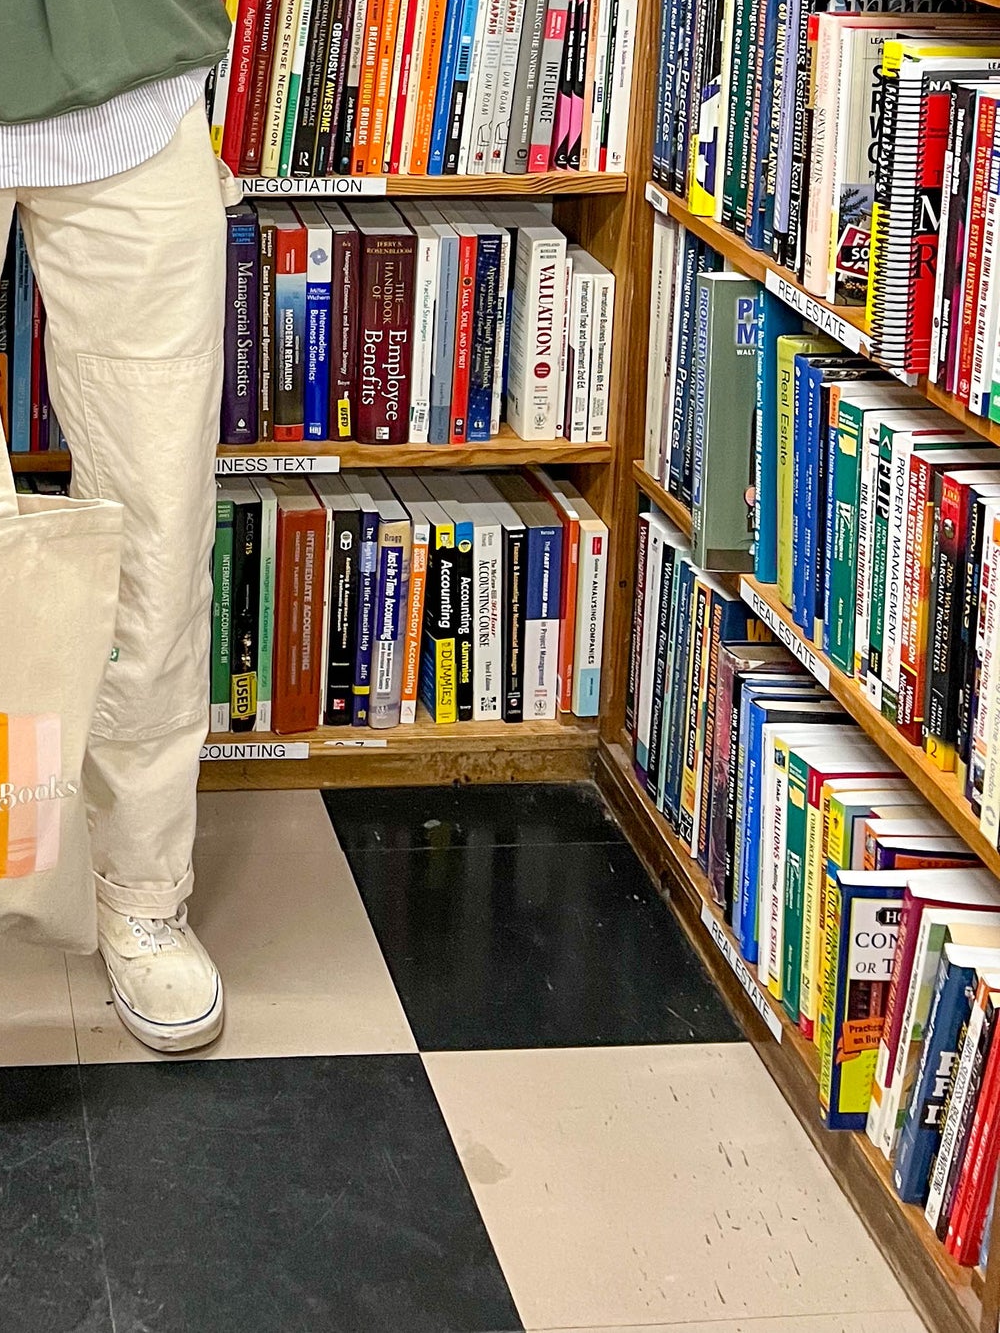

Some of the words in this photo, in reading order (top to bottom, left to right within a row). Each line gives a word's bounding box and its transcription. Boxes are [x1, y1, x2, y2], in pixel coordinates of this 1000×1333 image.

[779, 3, 787, 21] 60
[775, 23, 786, 75] MINUTE
[538, 62, 558, 124] INFLUENCE
[771, 78, 781, 129] ESTATE
[242, 178, 362, 193] NEGOTIATION
[766, 132, 777, 195] PLANNER
[536, 264, 557, 356] VALUATION
[777, 280, 804, 307] REAL
[806, 300, 846, 342] ESTATE
[363, 329, 385, 405] Benefits
[383, 329, 408, 423] Employee
[217, 458, 268, 473] INESS
[273, 457, 317, 472] TEXT
[439, 560, 450, 628] Accounting
[752, 594, 776, 628] REAL
[777, 624, 817, 673] ESTATE
[237, 677, 248, 714] USED
[439, 651, 452, 706] DUMMIES
[711, 922, 734, 957] REAL
[734, 958, 771, 1019] ESTATE
